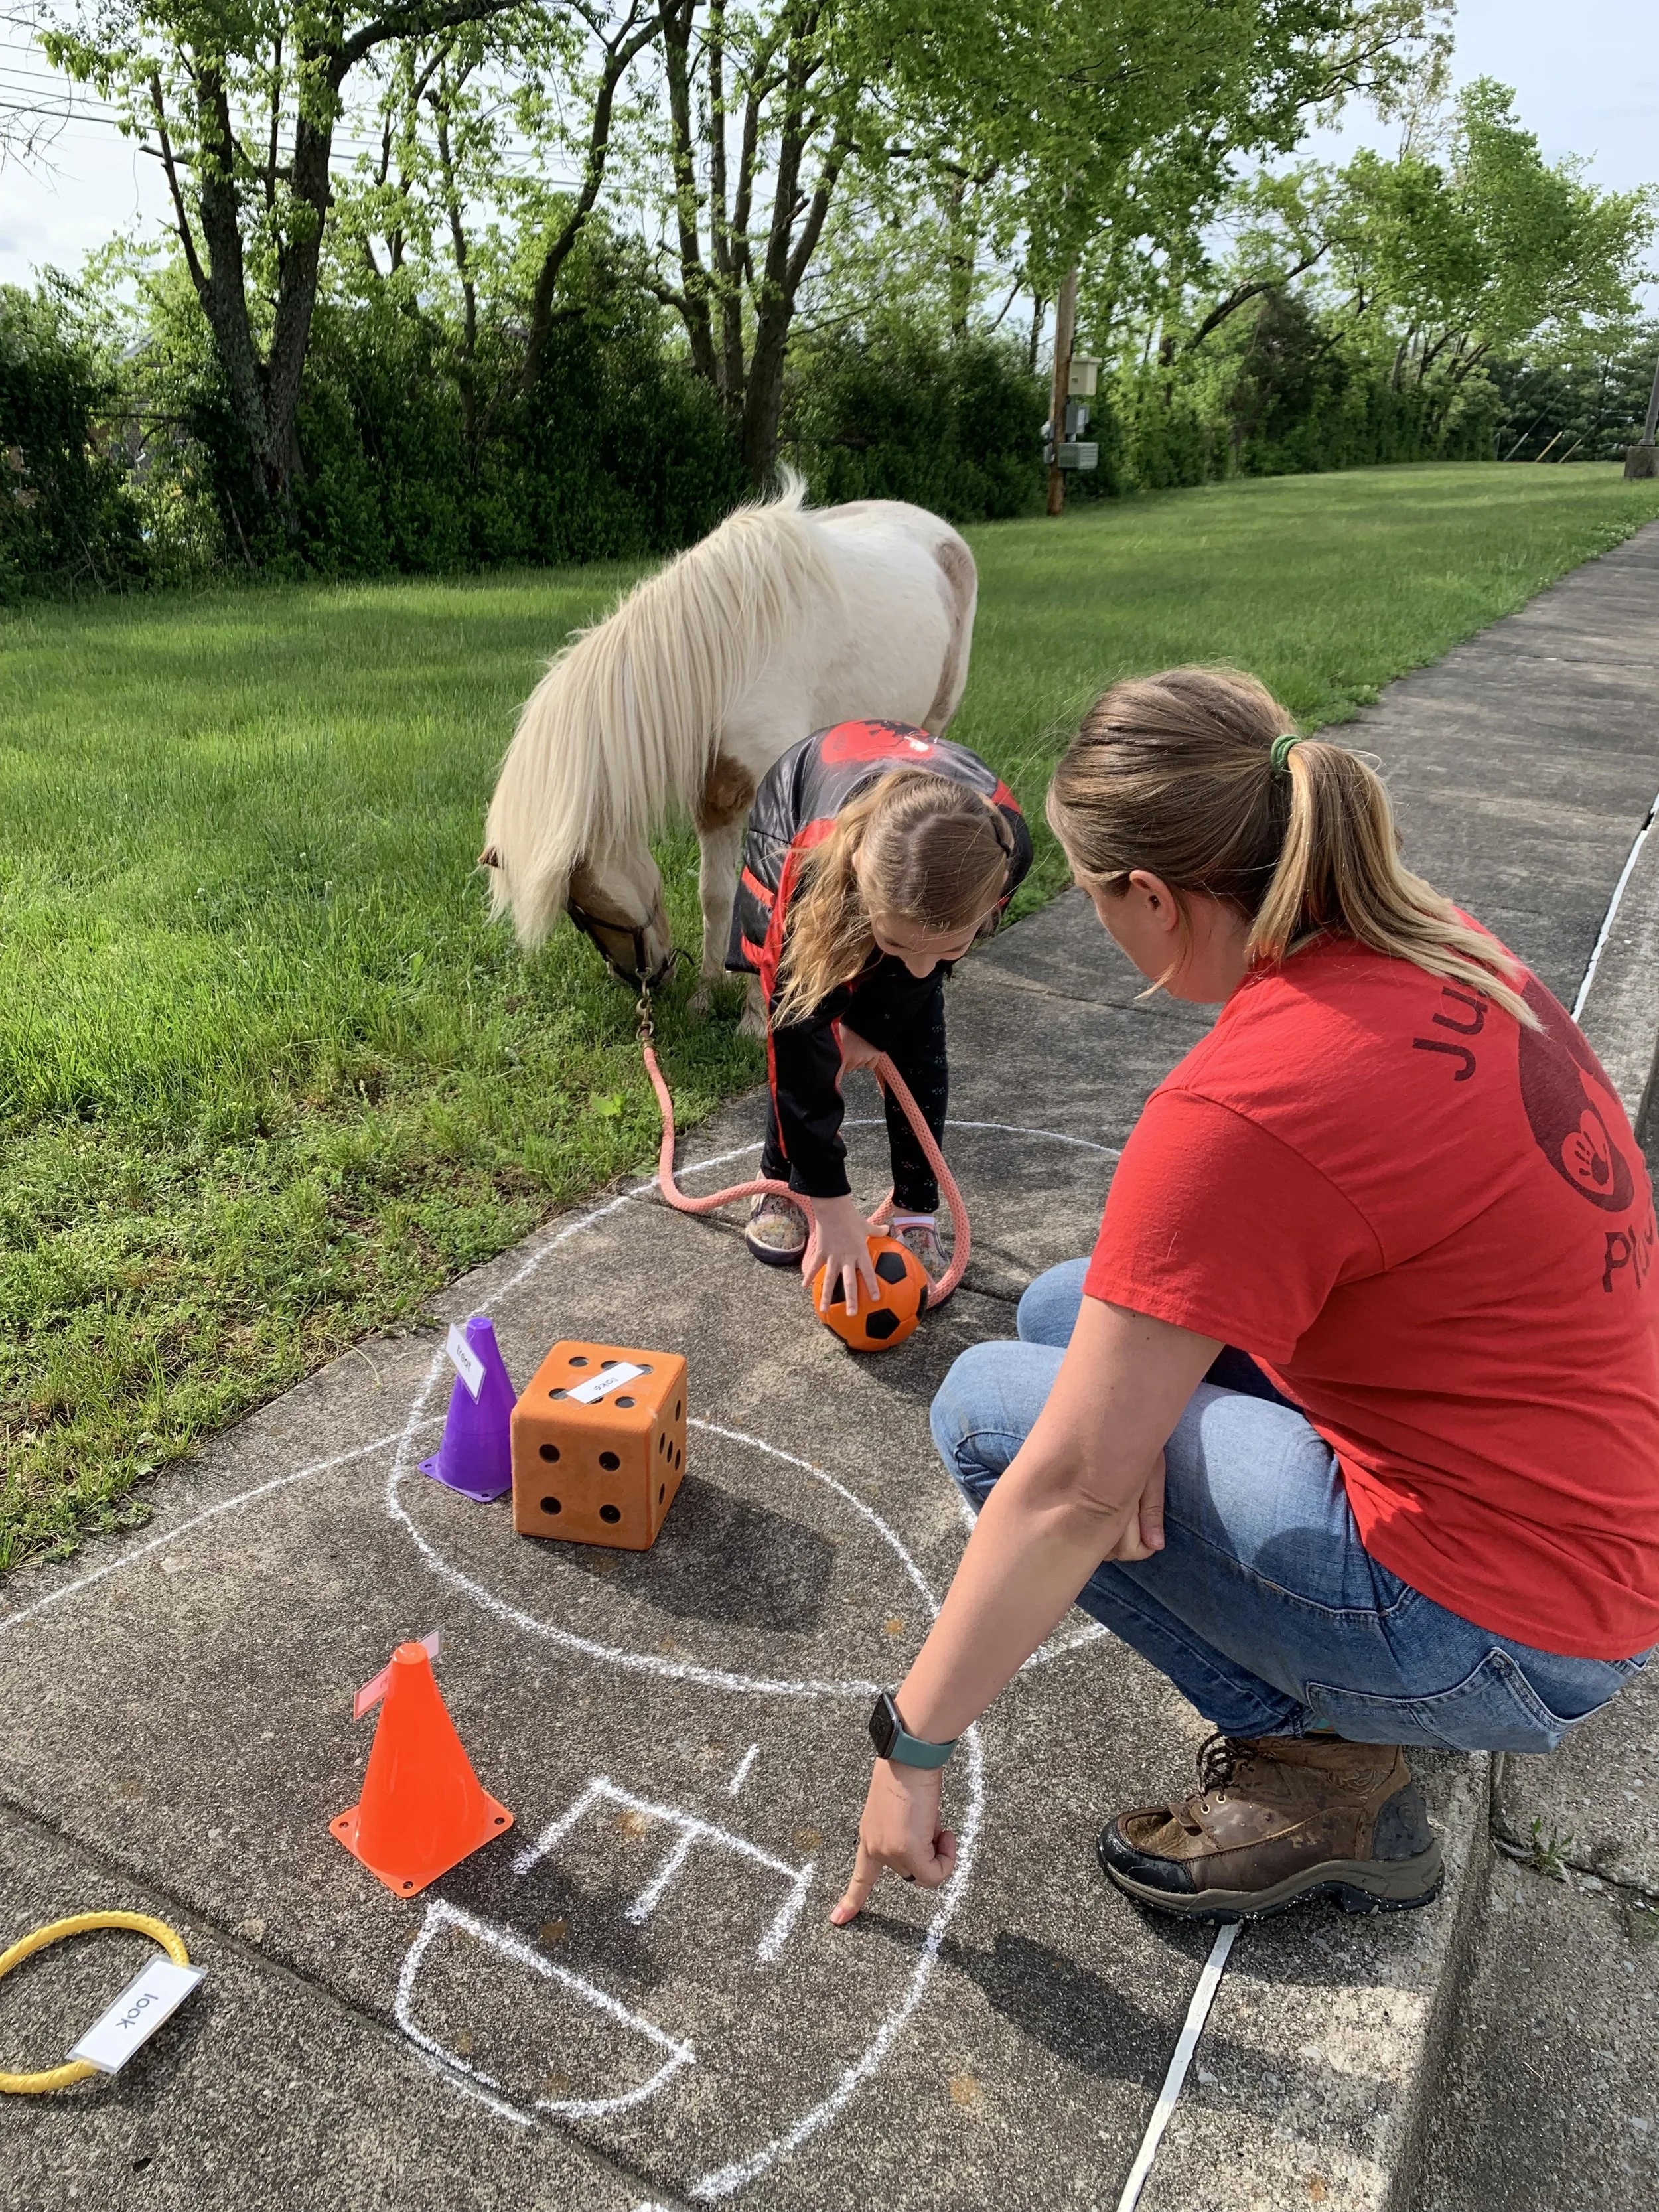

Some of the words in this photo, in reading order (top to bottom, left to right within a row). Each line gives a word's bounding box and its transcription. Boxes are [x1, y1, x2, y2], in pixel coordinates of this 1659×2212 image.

[1413, 970, 1493, 1081] Ju
[456, 1344, 472, 1372] treat
[593, 1377, 619, 1391] take
[115, 1993, 159, 2029] look
